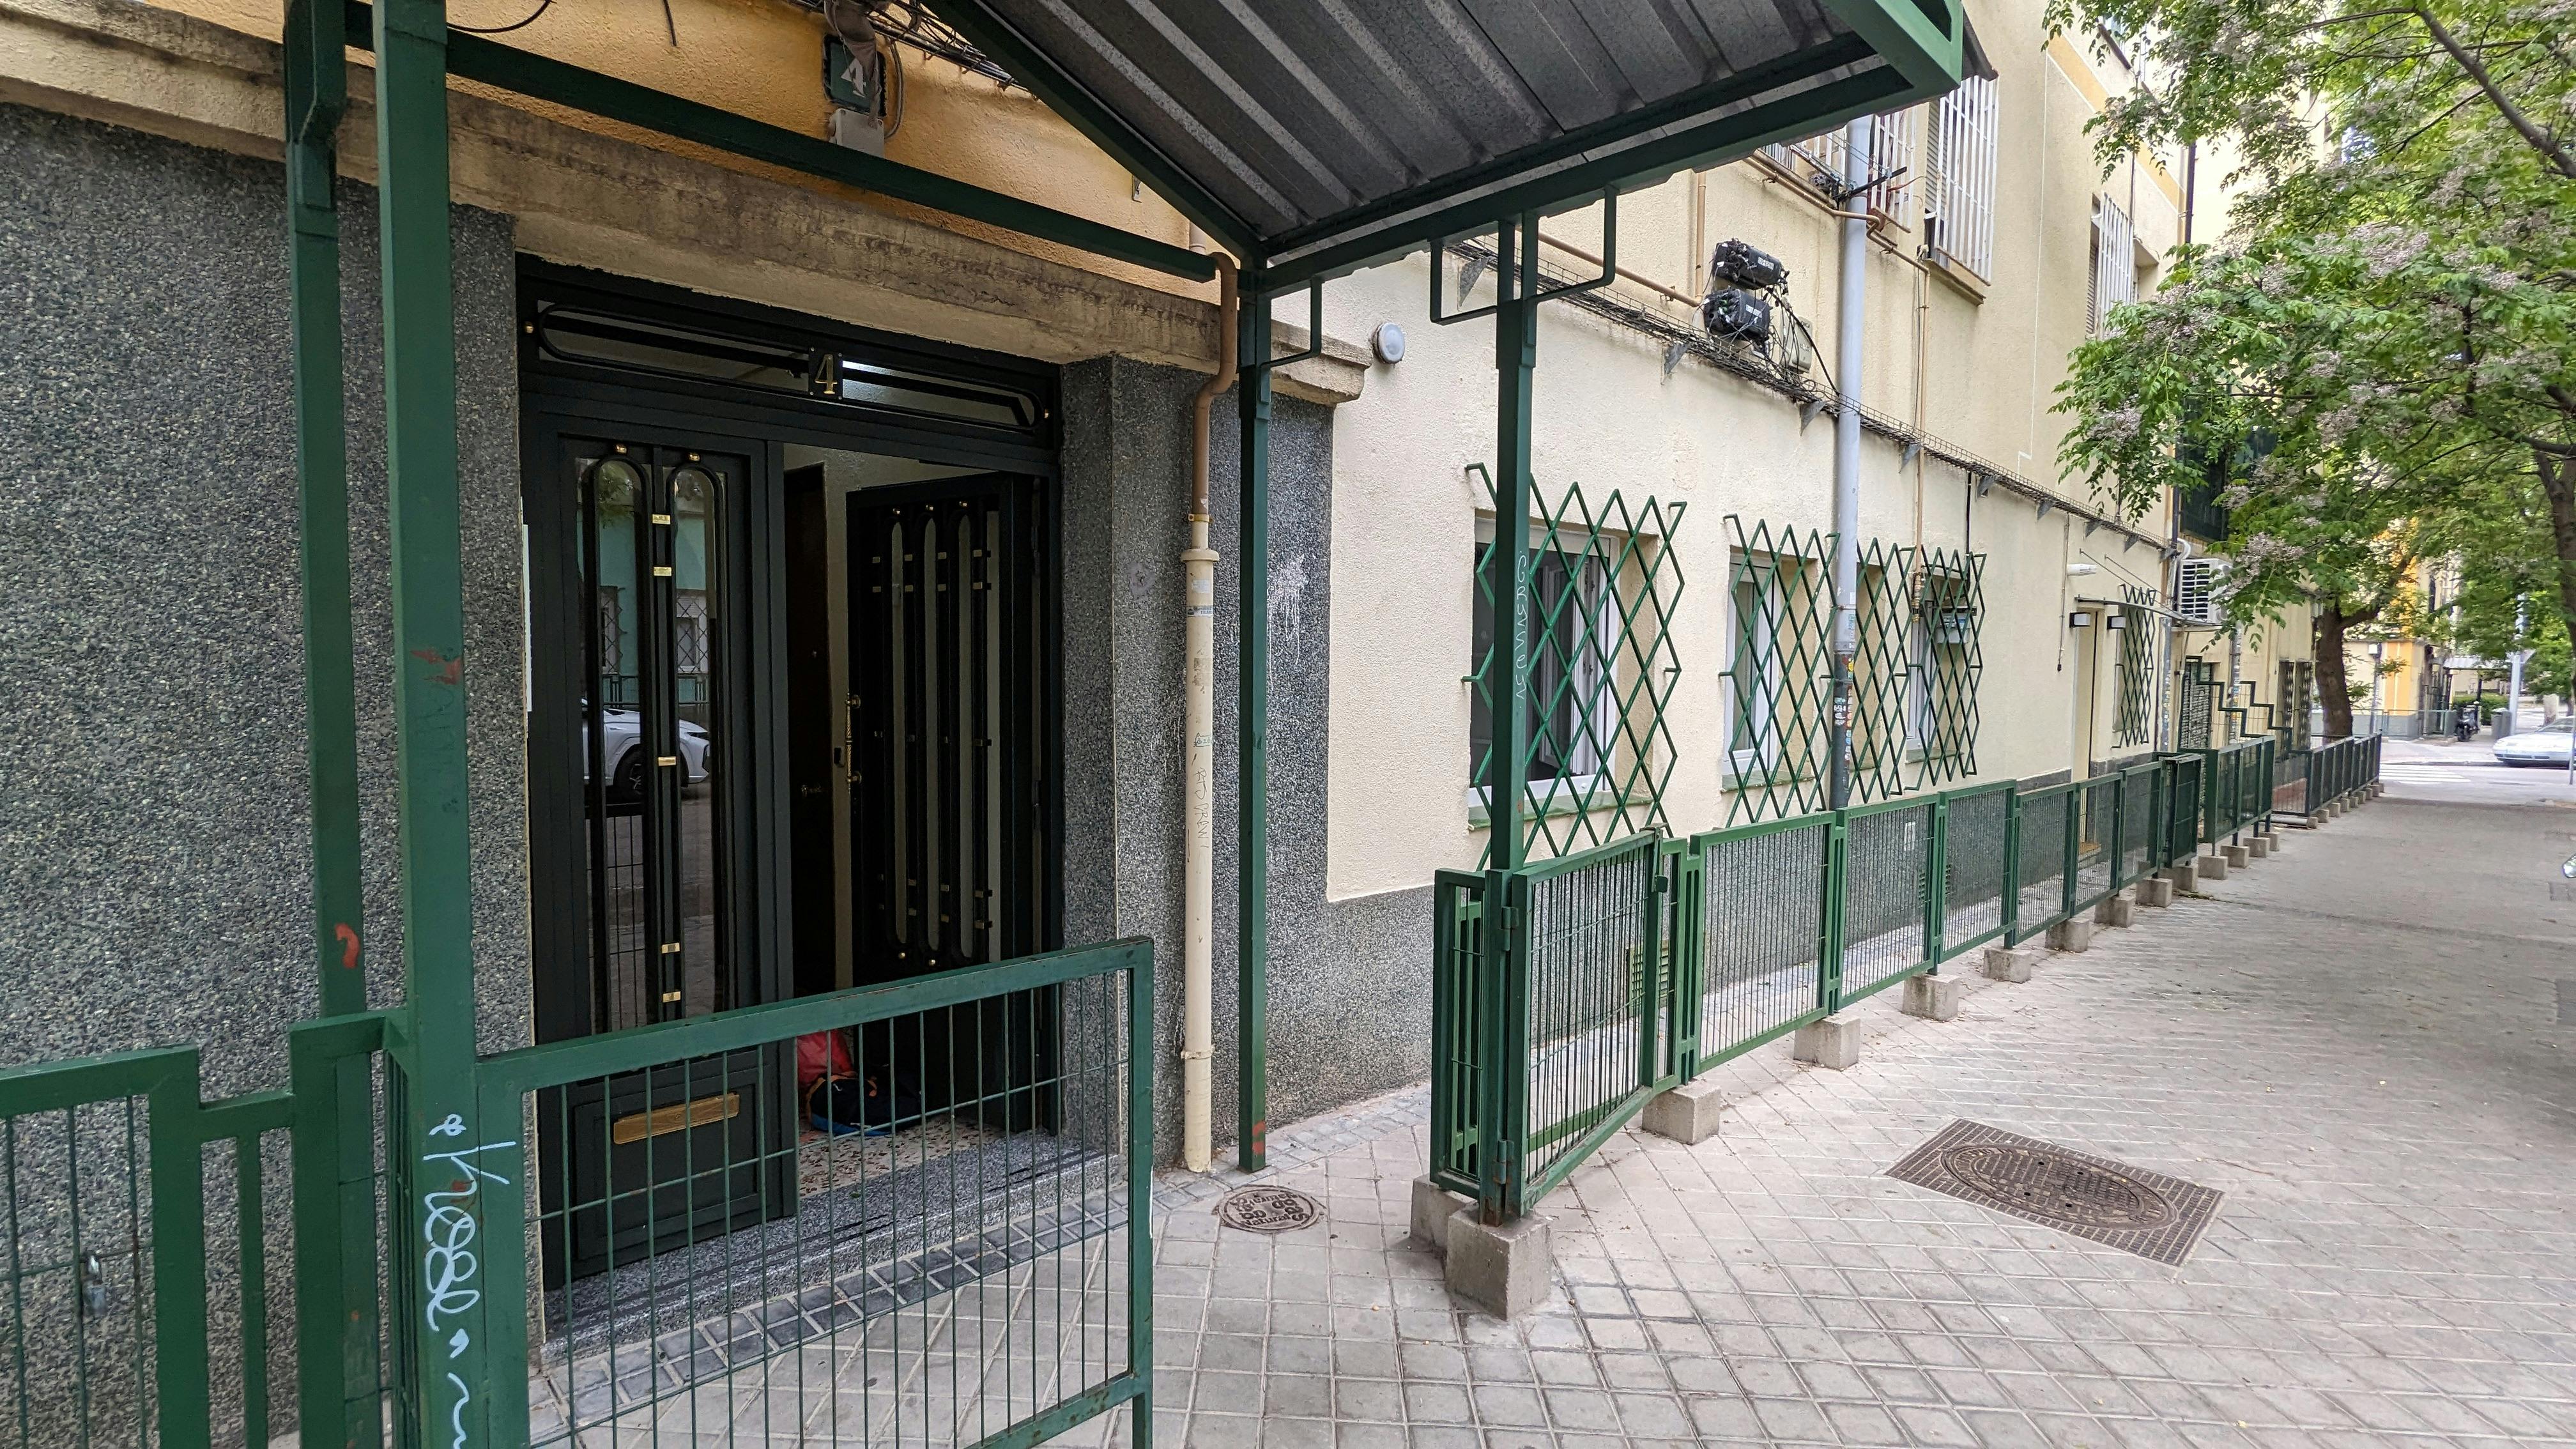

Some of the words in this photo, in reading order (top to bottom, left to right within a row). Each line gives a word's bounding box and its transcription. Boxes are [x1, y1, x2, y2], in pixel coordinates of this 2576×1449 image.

[841, 57, 866, 98] 4
[815, 354, 838, 394] 4
[1241, 1213, 1291, 1226] Natural
